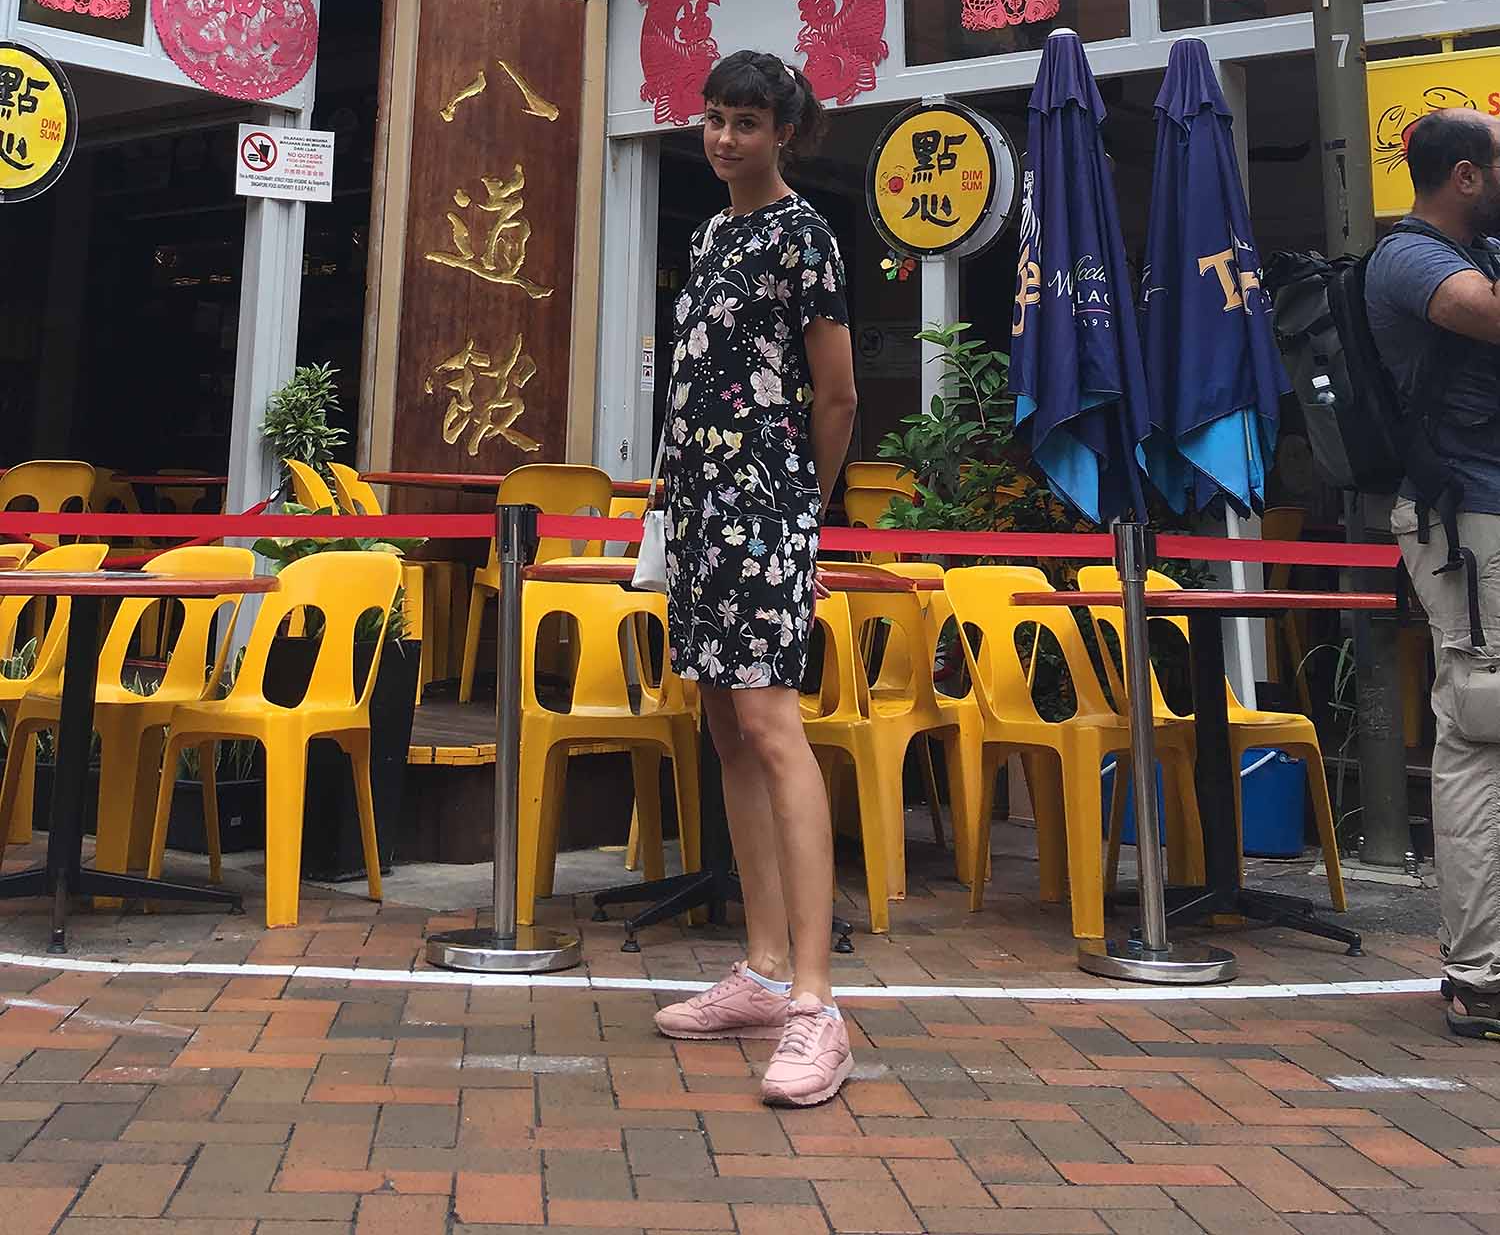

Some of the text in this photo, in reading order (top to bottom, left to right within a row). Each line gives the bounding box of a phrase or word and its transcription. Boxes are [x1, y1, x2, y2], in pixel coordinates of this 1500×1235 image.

[1331, 33, 1350, 68] 7
[41, 118, 62, 132] DIM
[40, 129, 61, 142] SUM
[902, 130, 967, 227] 點心
[962, 171, 983, 180] DIM
[961, 181, 982, 191] SUM
